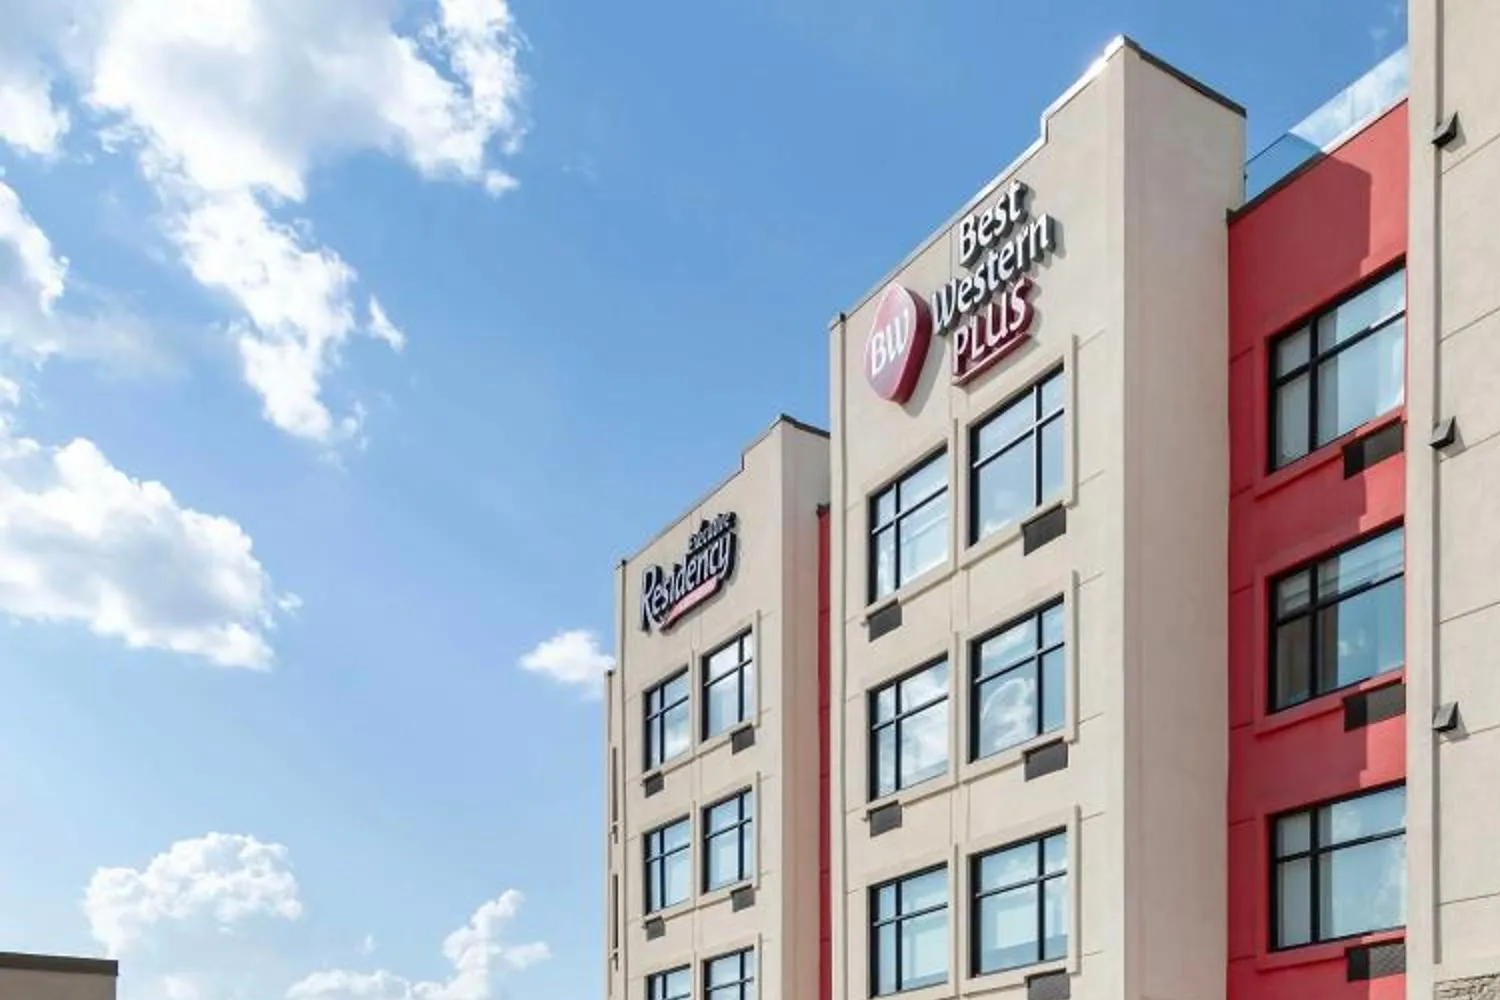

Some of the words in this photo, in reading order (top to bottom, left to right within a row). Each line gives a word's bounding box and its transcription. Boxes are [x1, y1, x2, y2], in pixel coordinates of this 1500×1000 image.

[958, 180, 1023, 266] Best
[931, 213, 1051, 331] Western
[870, 307, 910, 378] BW
[952, 277, 1028, 376] PLUS
[640, 532, 732, 625] Residency
